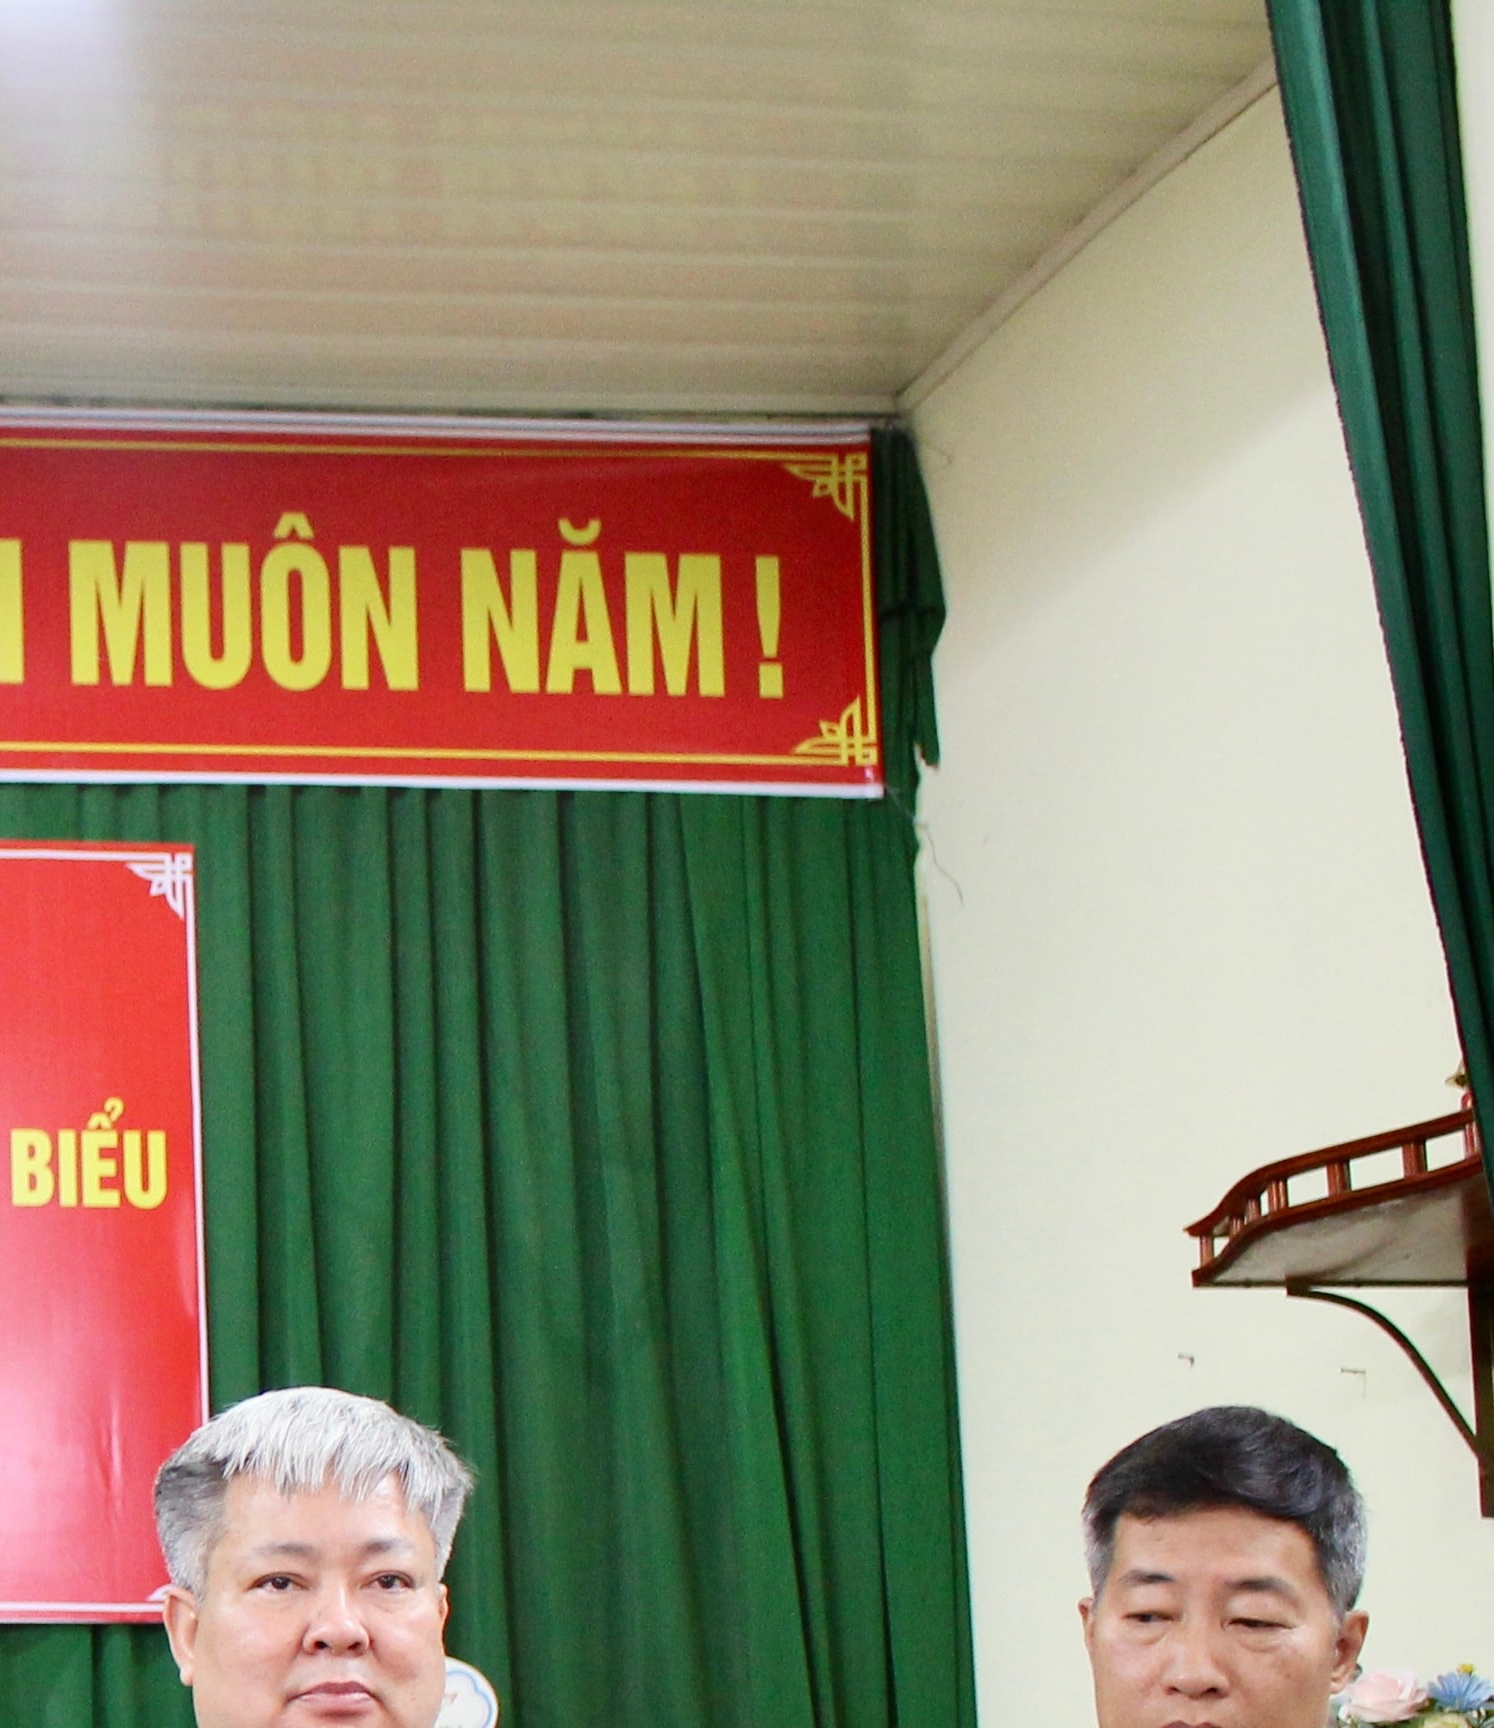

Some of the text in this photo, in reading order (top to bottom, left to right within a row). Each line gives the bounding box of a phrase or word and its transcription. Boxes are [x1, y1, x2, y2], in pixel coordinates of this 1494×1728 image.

[68, 512, 419, 691] MUÔN
[460, 518, 725, 697] NĂM
[10, 1098, 167, 1209] BIỂU
